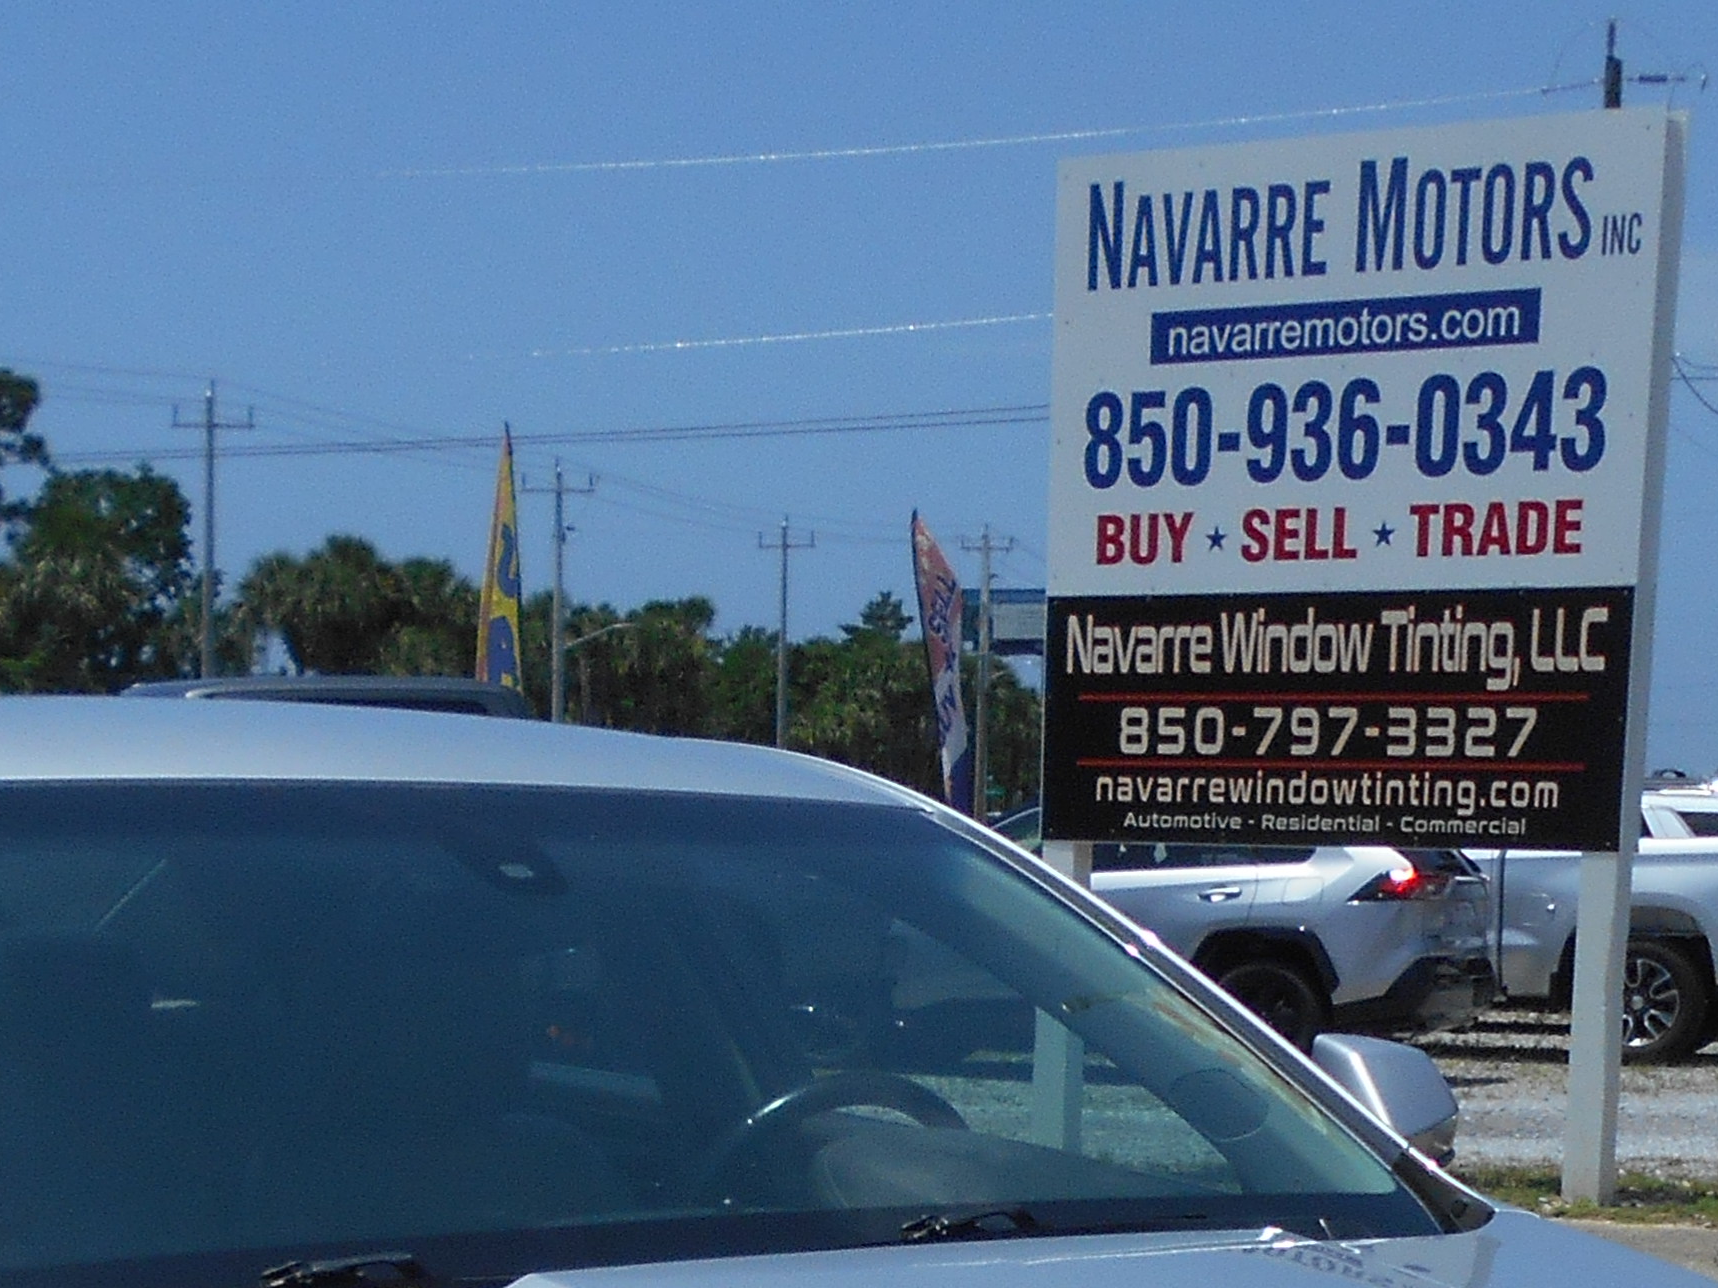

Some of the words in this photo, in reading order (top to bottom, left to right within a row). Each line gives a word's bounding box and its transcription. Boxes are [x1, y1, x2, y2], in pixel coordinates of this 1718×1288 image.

[1087, 179, 1331, 291] NAVARRE
[1356, 155, 1595, 273] MOTORS
[1601, 213, 1643, 256] INC
[1167, 303, 1521, 357] navarremotors.com
[1084, 365, 1608, 490] 850-936-0343
[1096, 511, 1194, 566] BUY
[1241, 506, 1357, 563] SELL
[1410, 499, 1584, 558] TRADE
[1066, 614, 1213, 675] Navarre
[1221, 607, 1374, 674] Window
[1381, 604, 1521, 691] Tinting,
[1530, 607, 1609, 672] LLC
[1119, 706, 1539, 757] 850-797-3327
[1096, 770, 1558, 815] navarrewindowtinting.com
[1123, 812, 1242, 832] Automotive
[1261, 813, 1380, 834] Residential
[1400, 815, 1525, 835] Commercial
